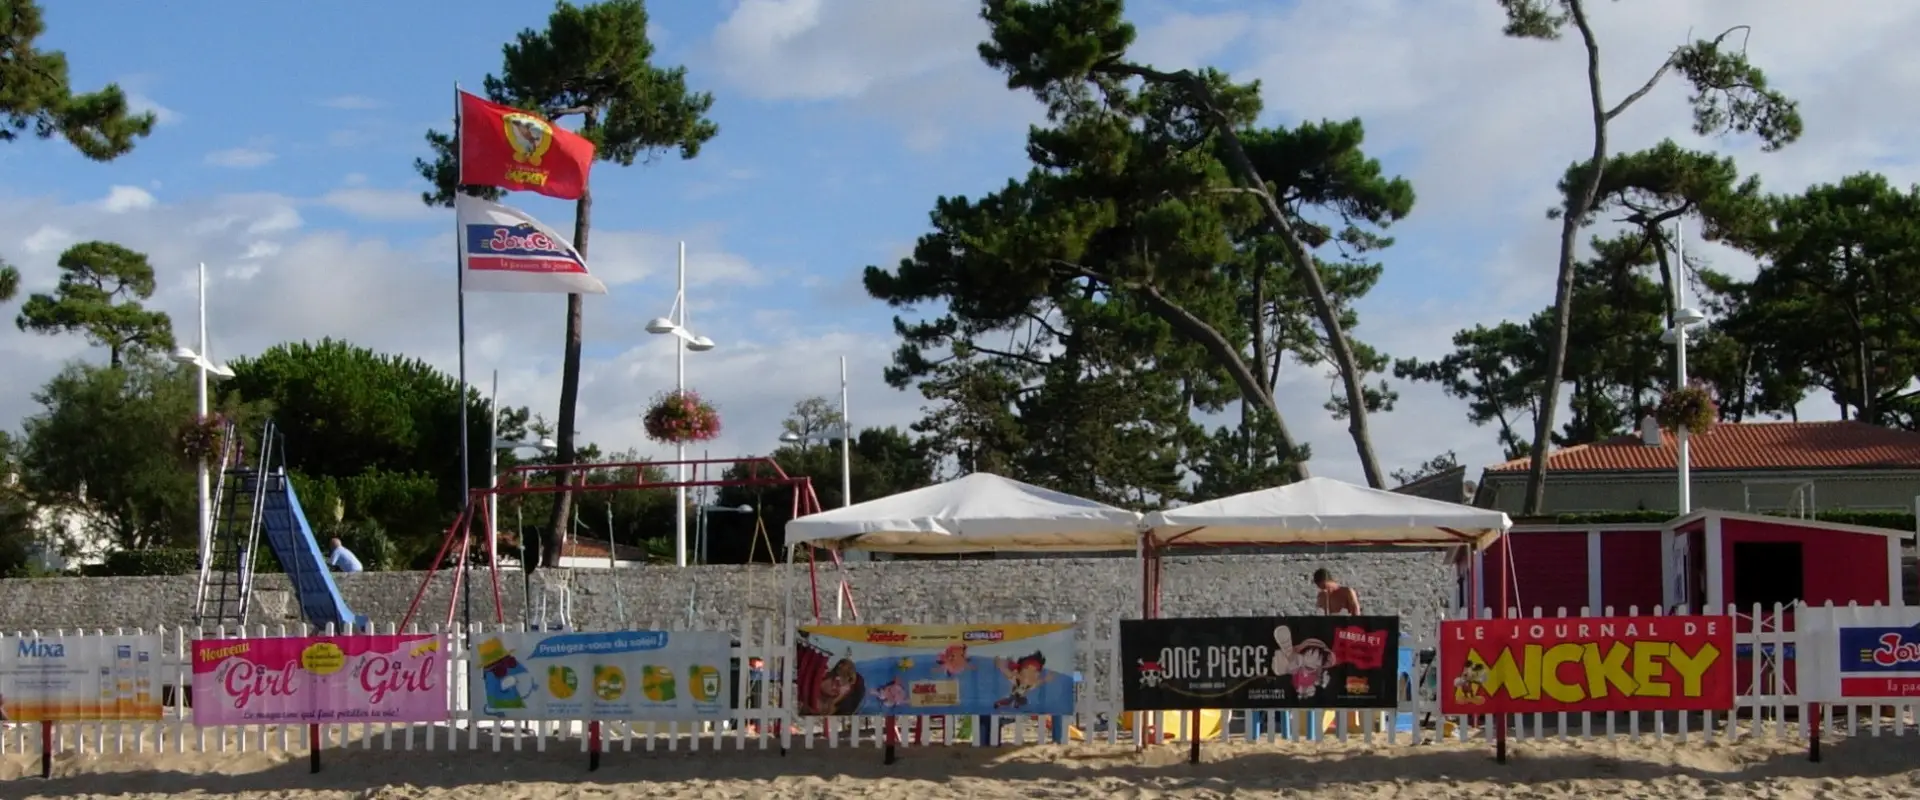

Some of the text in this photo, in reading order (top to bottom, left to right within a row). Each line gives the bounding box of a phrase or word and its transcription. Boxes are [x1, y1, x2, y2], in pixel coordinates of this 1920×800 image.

[1457, 622, 1717, 640] LE JOURNAL DE
[17, 639, 65, 658] Mixa
[614, 638, 627, 648] du
[629, 636, 657, 646] soleil
[200, 642, 250, 663] Nouveau
[1160, 646, 1200, 679] ONE
[361, 656, 435, 704] Girl
[1454, 641, 1720, 704] MICKEY
[225, 659, 297, 709] Girl
[1887, 679, 1898, 691] la
[244, 711, 254, 720] Le
[257, 711, 299, 721] magazine
[301, 710, 316, 721] qui
[318, 709, 335, 721] fait
